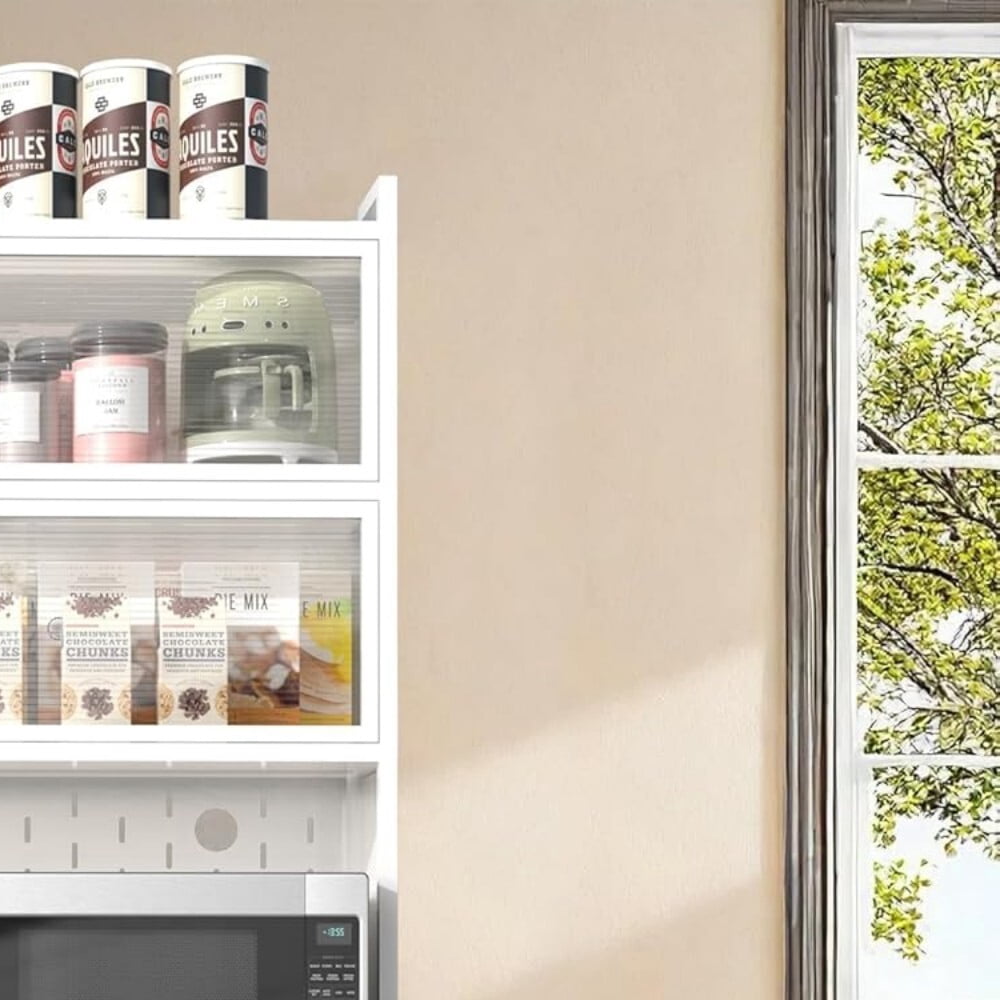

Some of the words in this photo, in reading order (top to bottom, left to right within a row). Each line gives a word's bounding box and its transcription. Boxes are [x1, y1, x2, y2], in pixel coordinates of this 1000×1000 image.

[83, 132, 140, 166] QUILES
[243, 593, 269, 611] MIX
[317, 601, 341, 617] MIX
[66, 631, 128, 639] SEMISWEET
[163, 631, 225, 639] SEMISWEET
[66, 639, 128, 647] CHOCOLATE
[163, 639, 225, 647] CHOCOLATE
[66, 647, 129, 659] CHUNKS
[163, 647, 226, 659] CHUNKS
